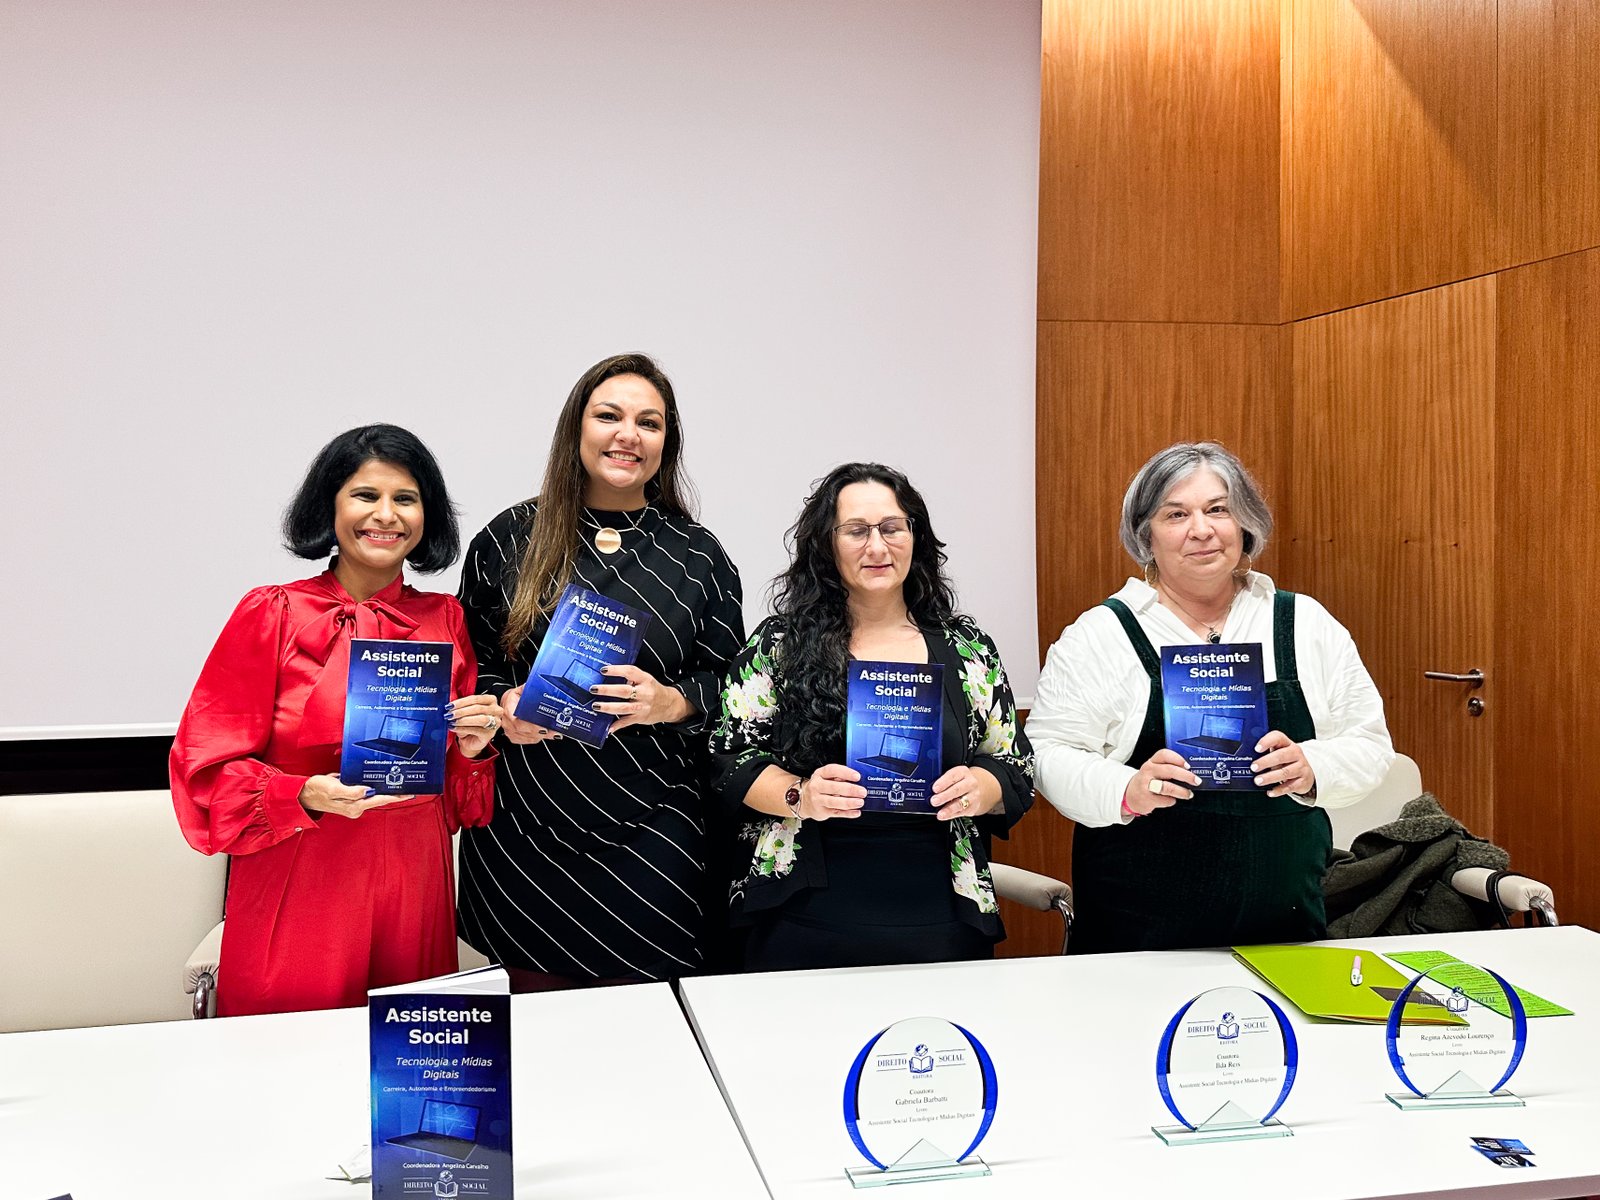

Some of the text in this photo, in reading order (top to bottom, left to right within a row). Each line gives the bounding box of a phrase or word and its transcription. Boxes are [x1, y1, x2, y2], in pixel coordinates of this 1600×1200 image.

[570, 595, 637, 628] Assistente
[579, 613, 618, 635] Social
[566, 627, 599, 644] Tecnologia
[606, 642, 626, 655] Mídias
[579, 641, 603, 654] Digitais
[361, 650, 440, 663] Assistente
[1173, 653, 1250, 664] Assistente
[377, 666, 422, 678] Social
[860, 670, 932, 683] Assistente
[1190, 667, 1234, 678] Social
[367, 685, 405, 693] Tecnologia
[875, 685, 916, 697] Social
[866, 703, 902, 712] Tecnologia
[910, 705, 931, 713] Mídias
[385, 1006, 492, 1022] Assistente
[1188, 1025, 1215, 1033] DIREITO
[409, 1029, 468, 1044] Social
[396, 1057, 448, 1067] Tecnologia
[461, 1056, 492, 1066] Mídias
[878, 1054, 964, 1067] DIREITO SOCIAL
[423, 1070, 459, 1080] Digitais
